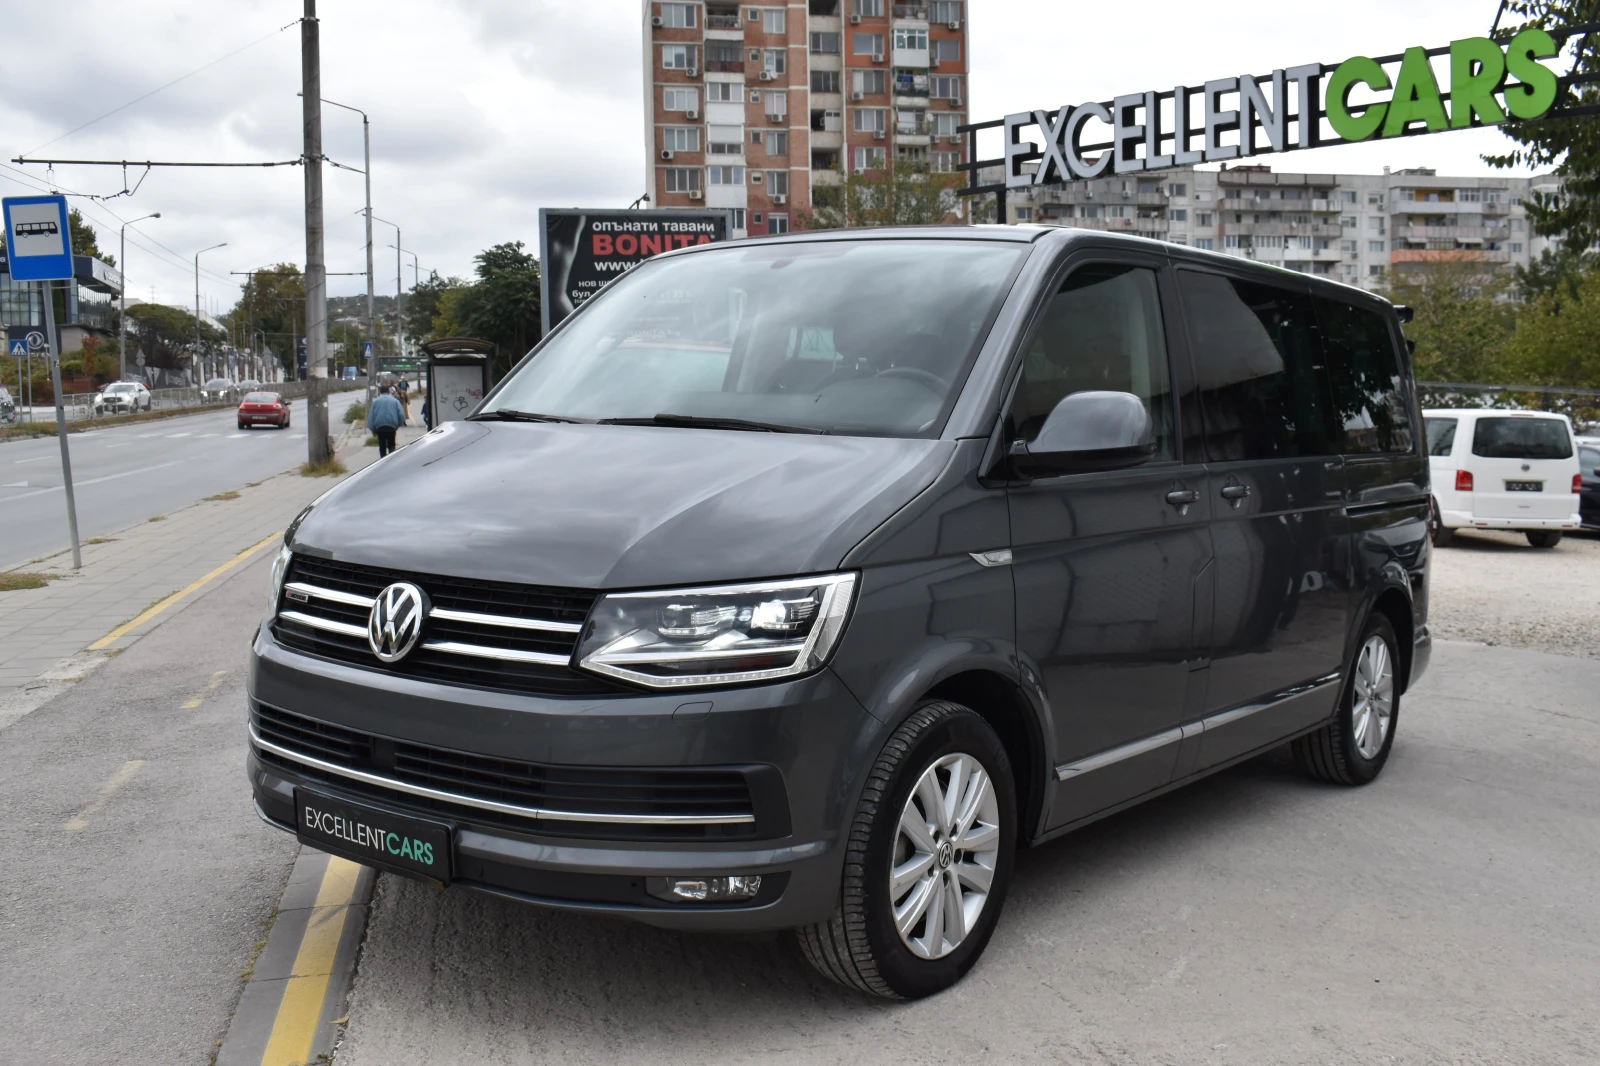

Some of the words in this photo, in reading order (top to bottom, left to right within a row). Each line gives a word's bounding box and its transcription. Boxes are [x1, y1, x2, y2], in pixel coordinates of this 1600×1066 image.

[592, 221, 658, 232] опънати
[662, 221, 715, 232] тавани
[578, 279, 597, 287] нов
[305, 806, 434, 865] EXCELLENTCARS
